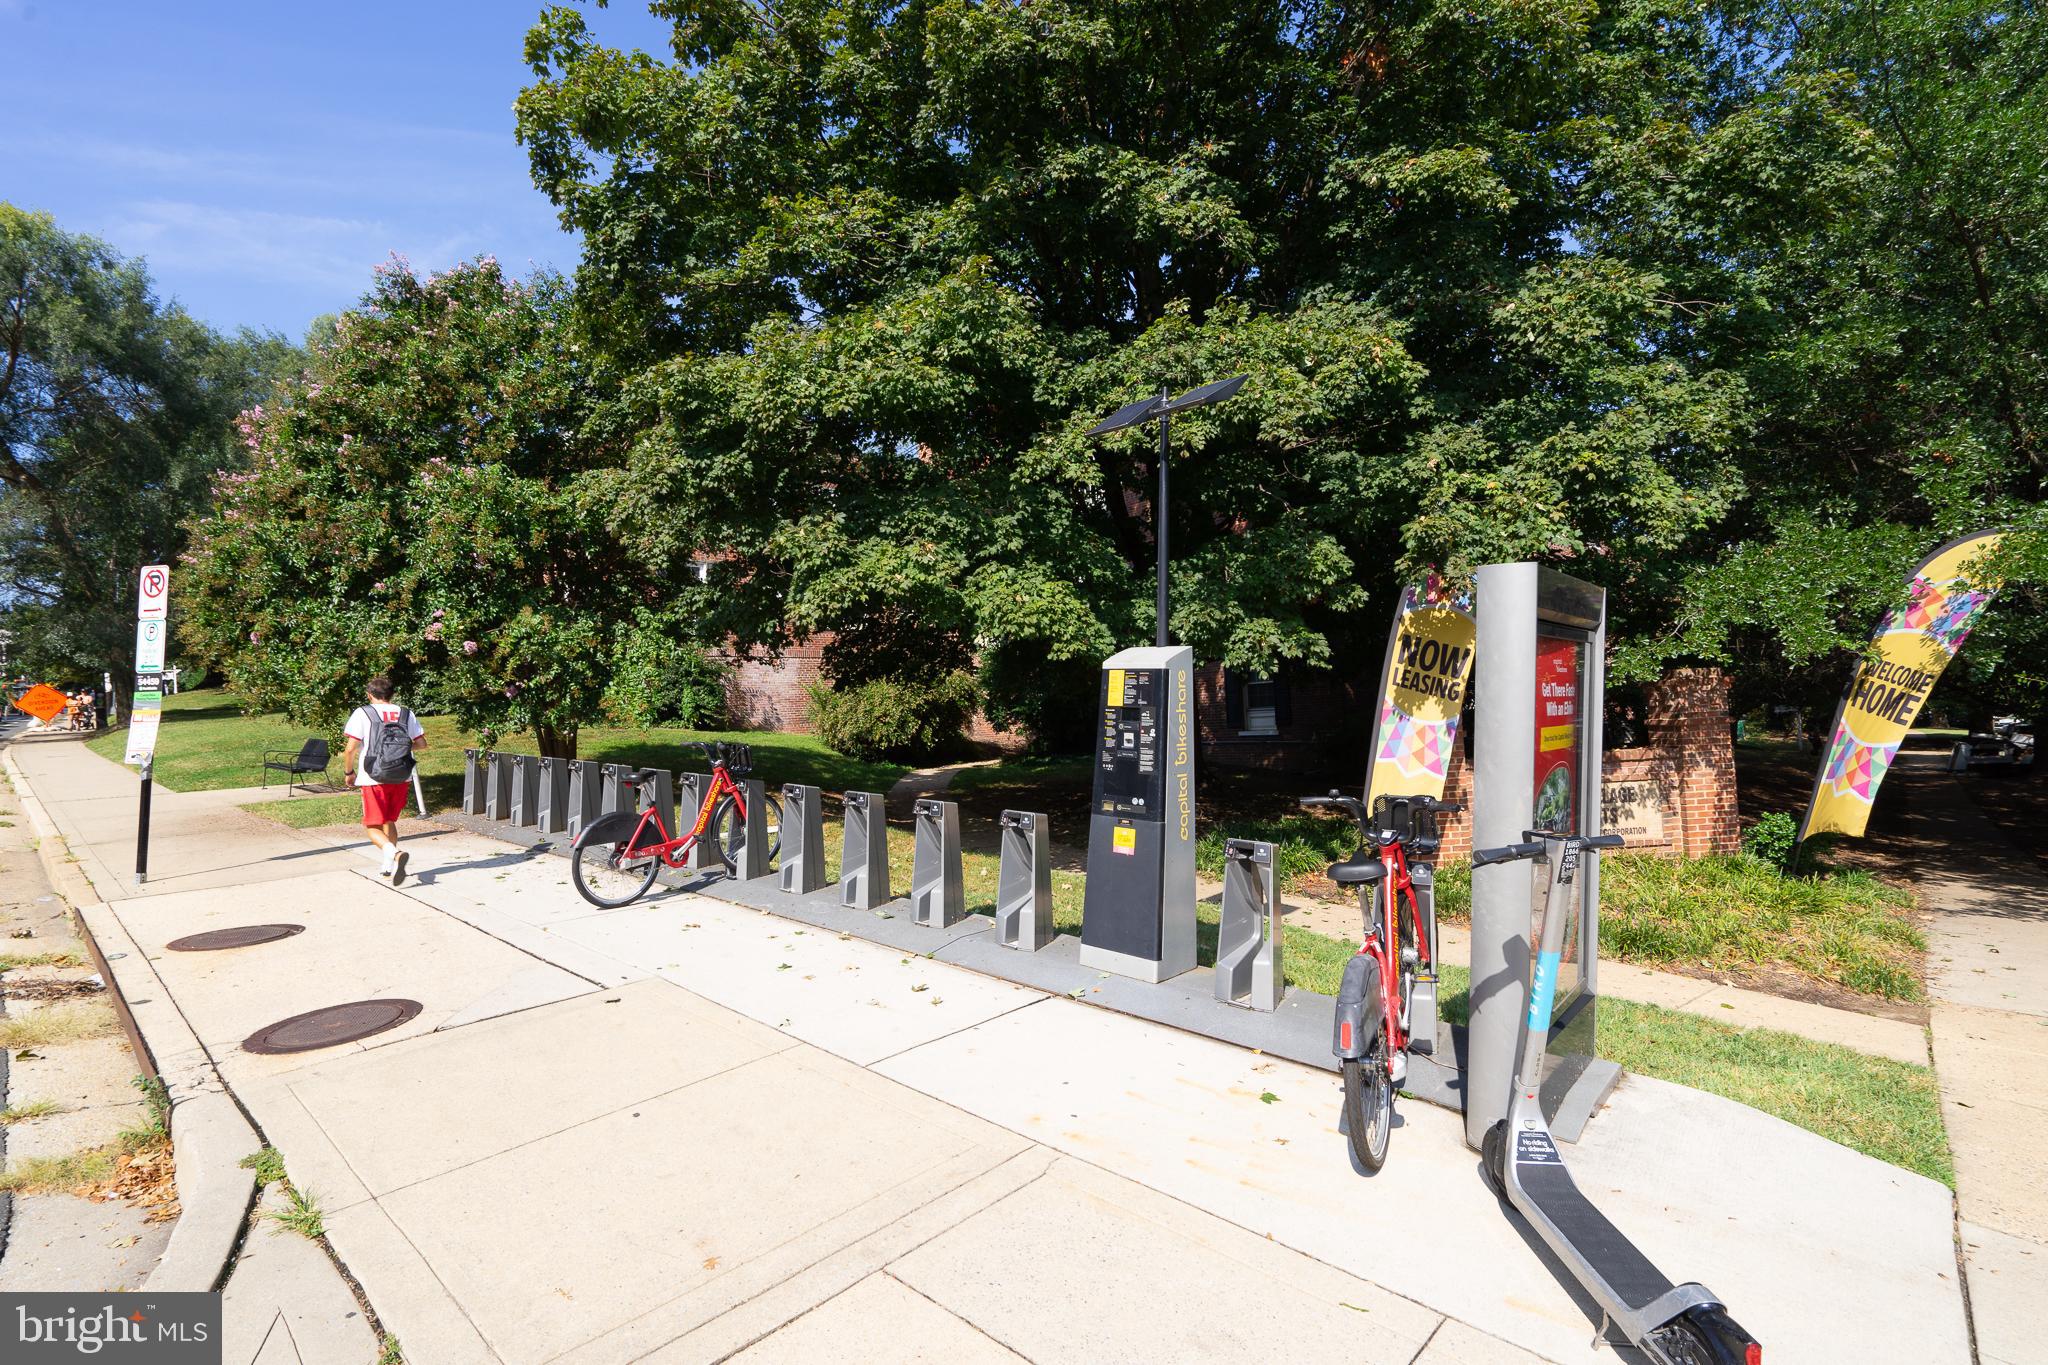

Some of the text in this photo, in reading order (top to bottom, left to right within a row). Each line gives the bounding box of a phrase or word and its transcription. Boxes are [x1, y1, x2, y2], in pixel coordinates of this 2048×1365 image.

[1398, 634, 1471, 679] NOW
[1392, 667, 1461, 702] LEASING
[1541, 682, 1551, 697] Get
[1551, 682, 1566, 697] There
[1863, 659, 1936, 694] WELCOME
[1546, 700, 1558, 717] With
[1851, 679, 1921, 727] HOME
[1174, 669, 1190, 841] capital bikeshare
[705, 780, 722, 812] bikeshare
[1566, 840, 1580, 849] BIRD
[1603, 827, 1647, 837] CORPORATION
[1530, 964, 1545, 1016] BIRD
[1522, 1138, 1531, 1146] No
